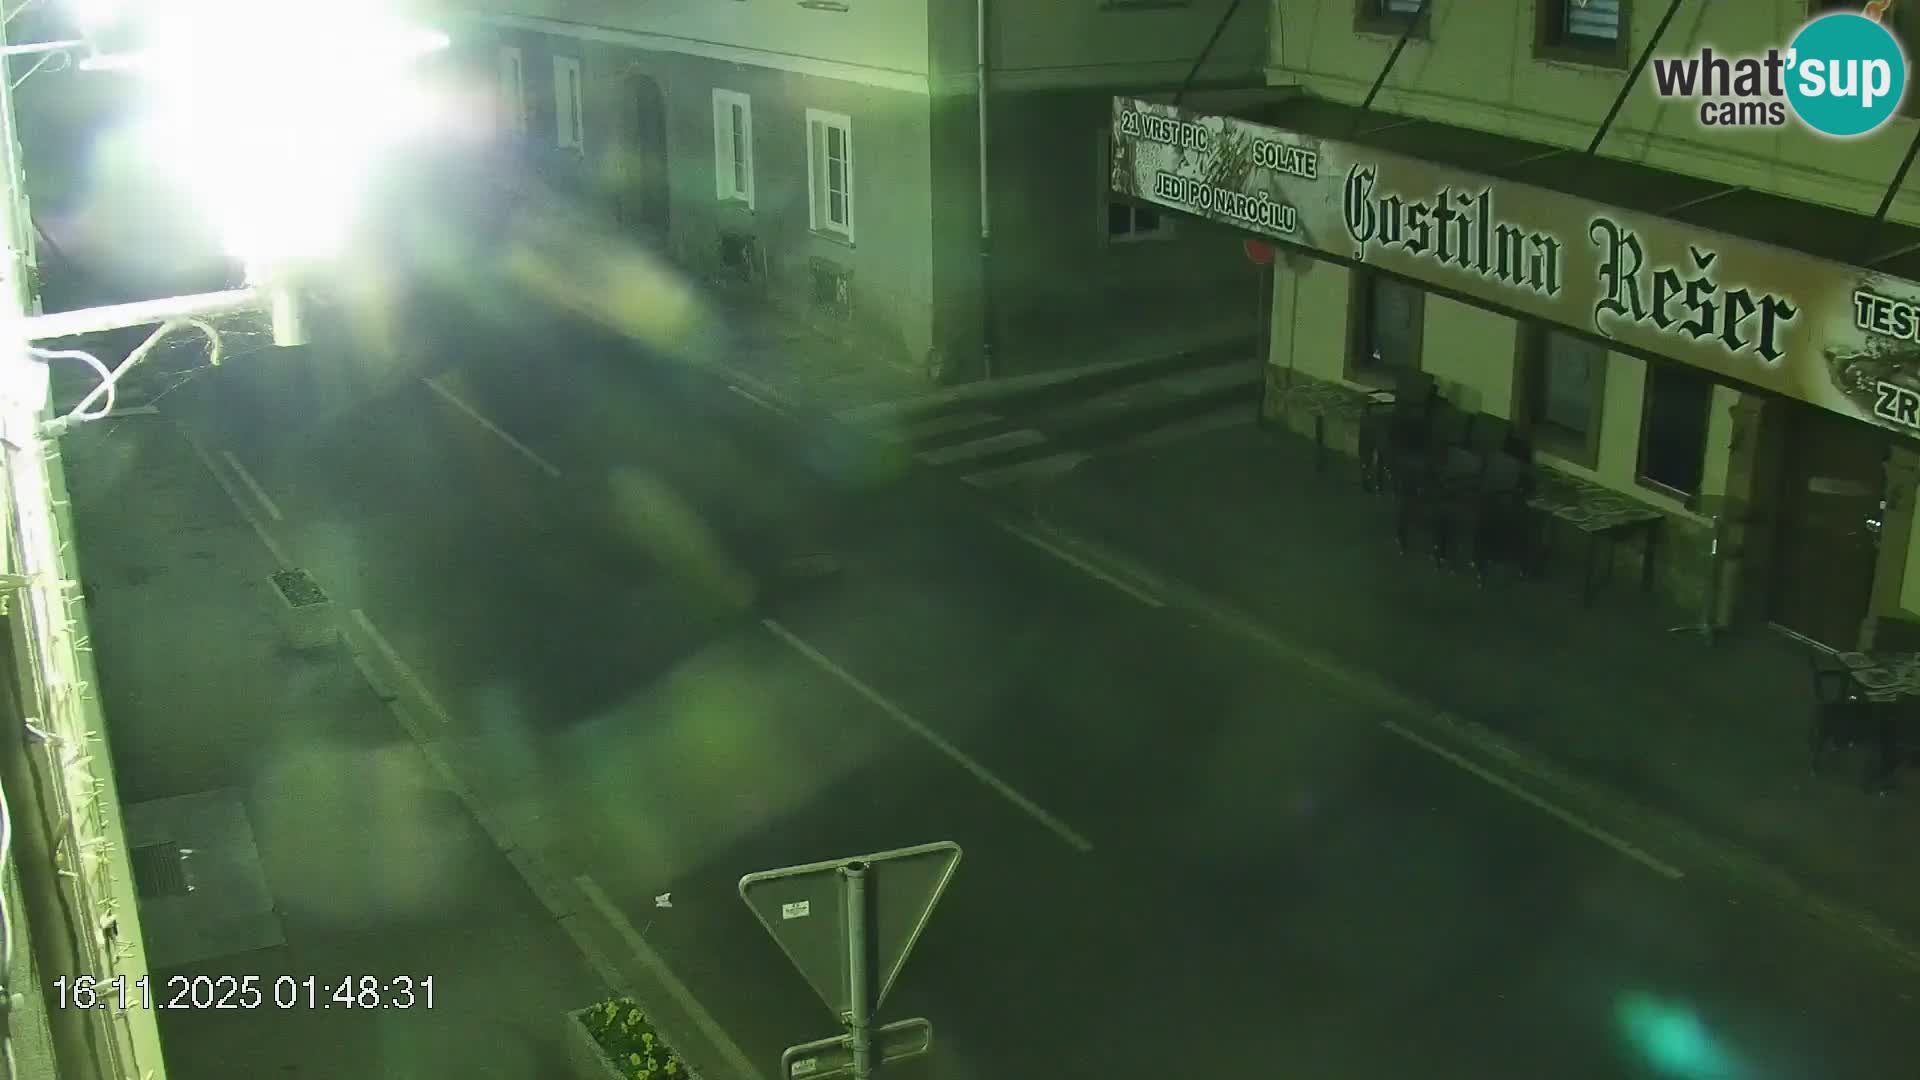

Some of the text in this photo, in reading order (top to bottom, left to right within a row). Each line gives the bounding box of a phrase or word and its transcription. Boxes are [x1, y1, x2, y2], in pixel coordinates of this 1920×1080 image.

[1122, 111, 1208, 151] 21 VRST PIC
[1253, 140, 1316, 178] SOLATE
[1155, 172, 1296, 232] JEDI PO NAROČILU
[1344, 162, 1799, 363] Gostilna Rešer
